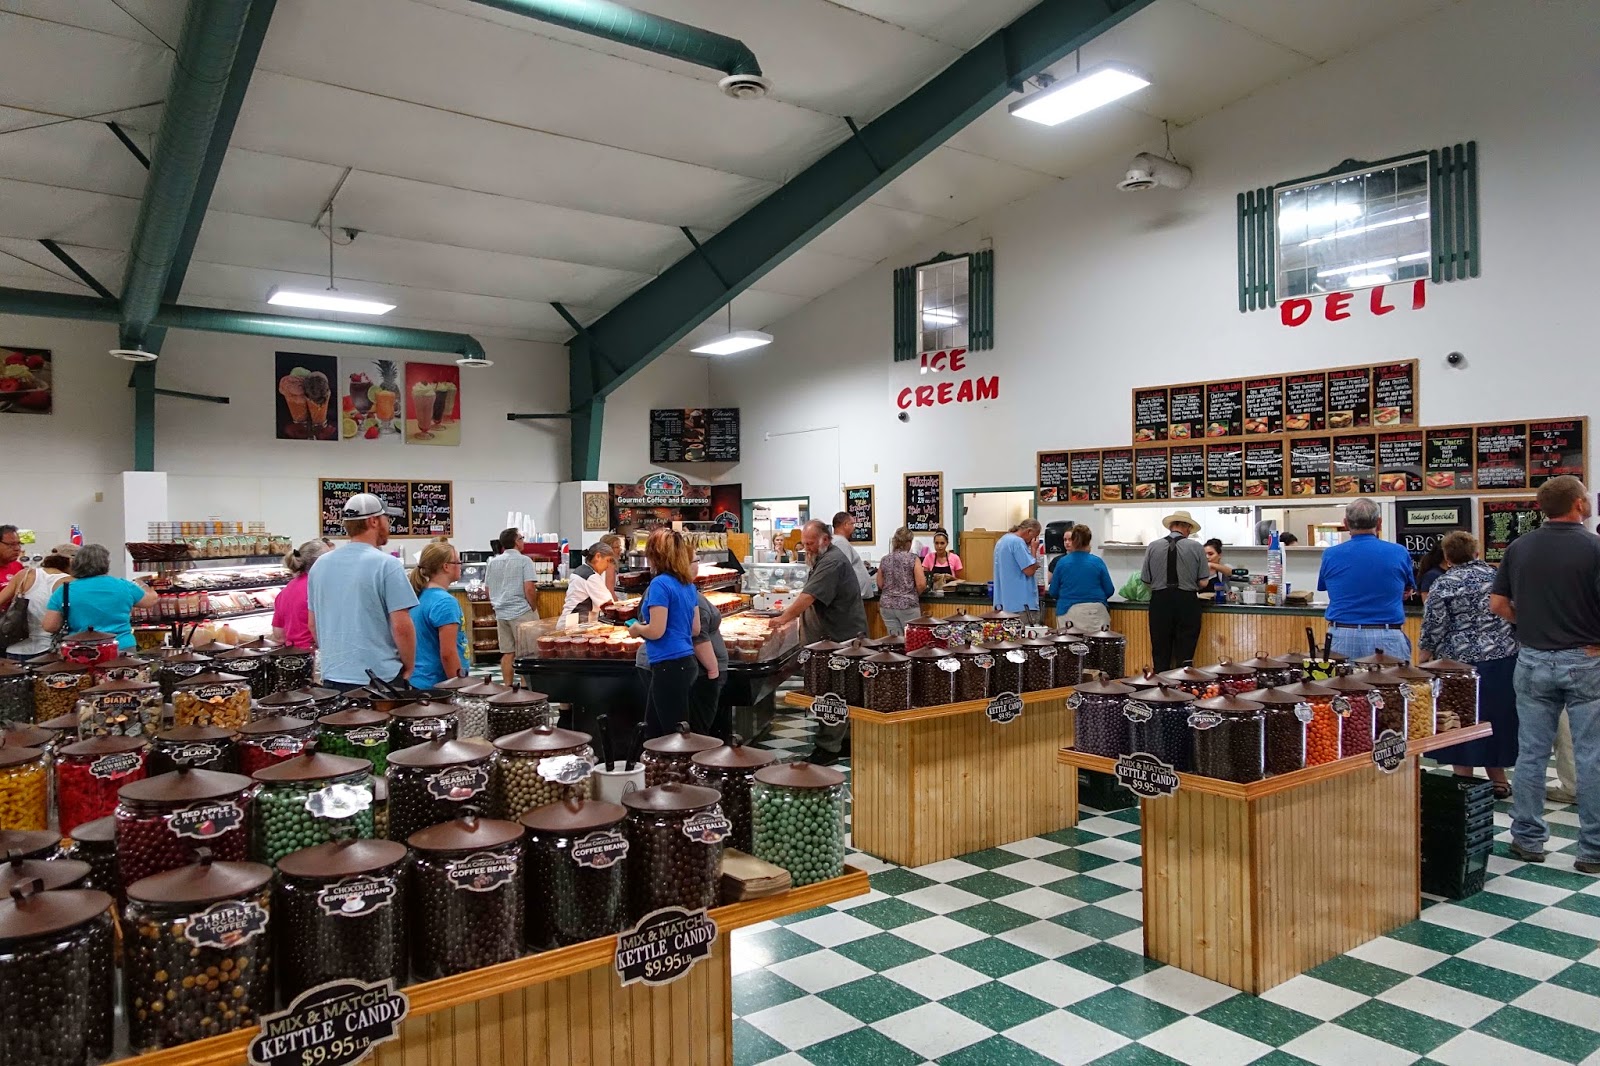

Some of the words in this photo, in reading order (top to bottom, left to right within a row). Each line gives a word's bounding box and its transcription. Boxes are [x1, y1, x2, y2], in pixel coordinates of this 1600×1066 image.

[1280, 279, 1426, 327] DELI
[920, 348, 967, 375] ICE
[897, 376, 999, 409] CREAM
[324, 481, 362, 490] Smoothies
[418, 484, 442, 492] Cones
[617, 496, 645, 504] Gourmet
[647, 496, 667, 504] Coffee
[668, 496, 680, 504] and
[681, 496, 709, 505] Espresso
[412, 505, 432, 513] Waffle
[433, 506, 450, 514] Cones
[1430, 512, 1455, 522] Specials
[104, 696, 132, 704] GIANT
[814, 703, 832, 713] KETTLE
[989, 704, 1008, 715] KETTLE
[182, 749, 212, 757] BLACK
[1121, 759, 1136, 769] MIX
[1136, 762, 1142, 770] &
[1142, 763, 1172, 776] MATCH
[440, 773, 477, 786] SEASALT
[1118, 765, 1147, 780] KETTLE
[1150, 772, 1177, 787] CANDY
[1132, 779, 1154, 793] $9.95
[174, 810, 238, 826] CARAMELS
[181, 810, 200, 819] RED
[201, 805, 231, 816] APPLE
[686, 824, 705, 833] MALT
[705, 821, 728, 830] BALLS
[575, 846, 604, 857] COFFEE
[603, 842, 627, 852] BEANS
[471, 859, 506, 868] CHOCOLATE
[451, 867, 486, 878] COFFEE
[486, 864, 515, 874] BEANS
[324, 891, 364, 902] ESPRESSO
[364, 886, 391, 897] BEANS
[333, 882, 379, 895] CHOCOLATE
[195, 911, 261, 931] CHOCOLATE
[201, 906, 252, 924] TRIPLE
[210, 920, 249, 934] TOFFEE
[622, 932, 647, 951] MIX
[648, 930, 658, 942] &
[659, 914, 704, 939] MATCH
[617, 938, 668, 970] KETTLE
[674, 923, 713, 950] CANDY
[644, 953, 681, 977] $9.95
[681, 954, 693, 965] LB
[269, 1013, 304, 1037] MIX
[307, 1010, 321, 1025] &
[323, 988, 389, 1019] MATCH
[260, 1019, 335, 1061] KETTLE
[345, 998, 402, 1033] CANDY
[301, 1036, 355, 1066] $9.95
[355, 1036, 370, 1051] LB
